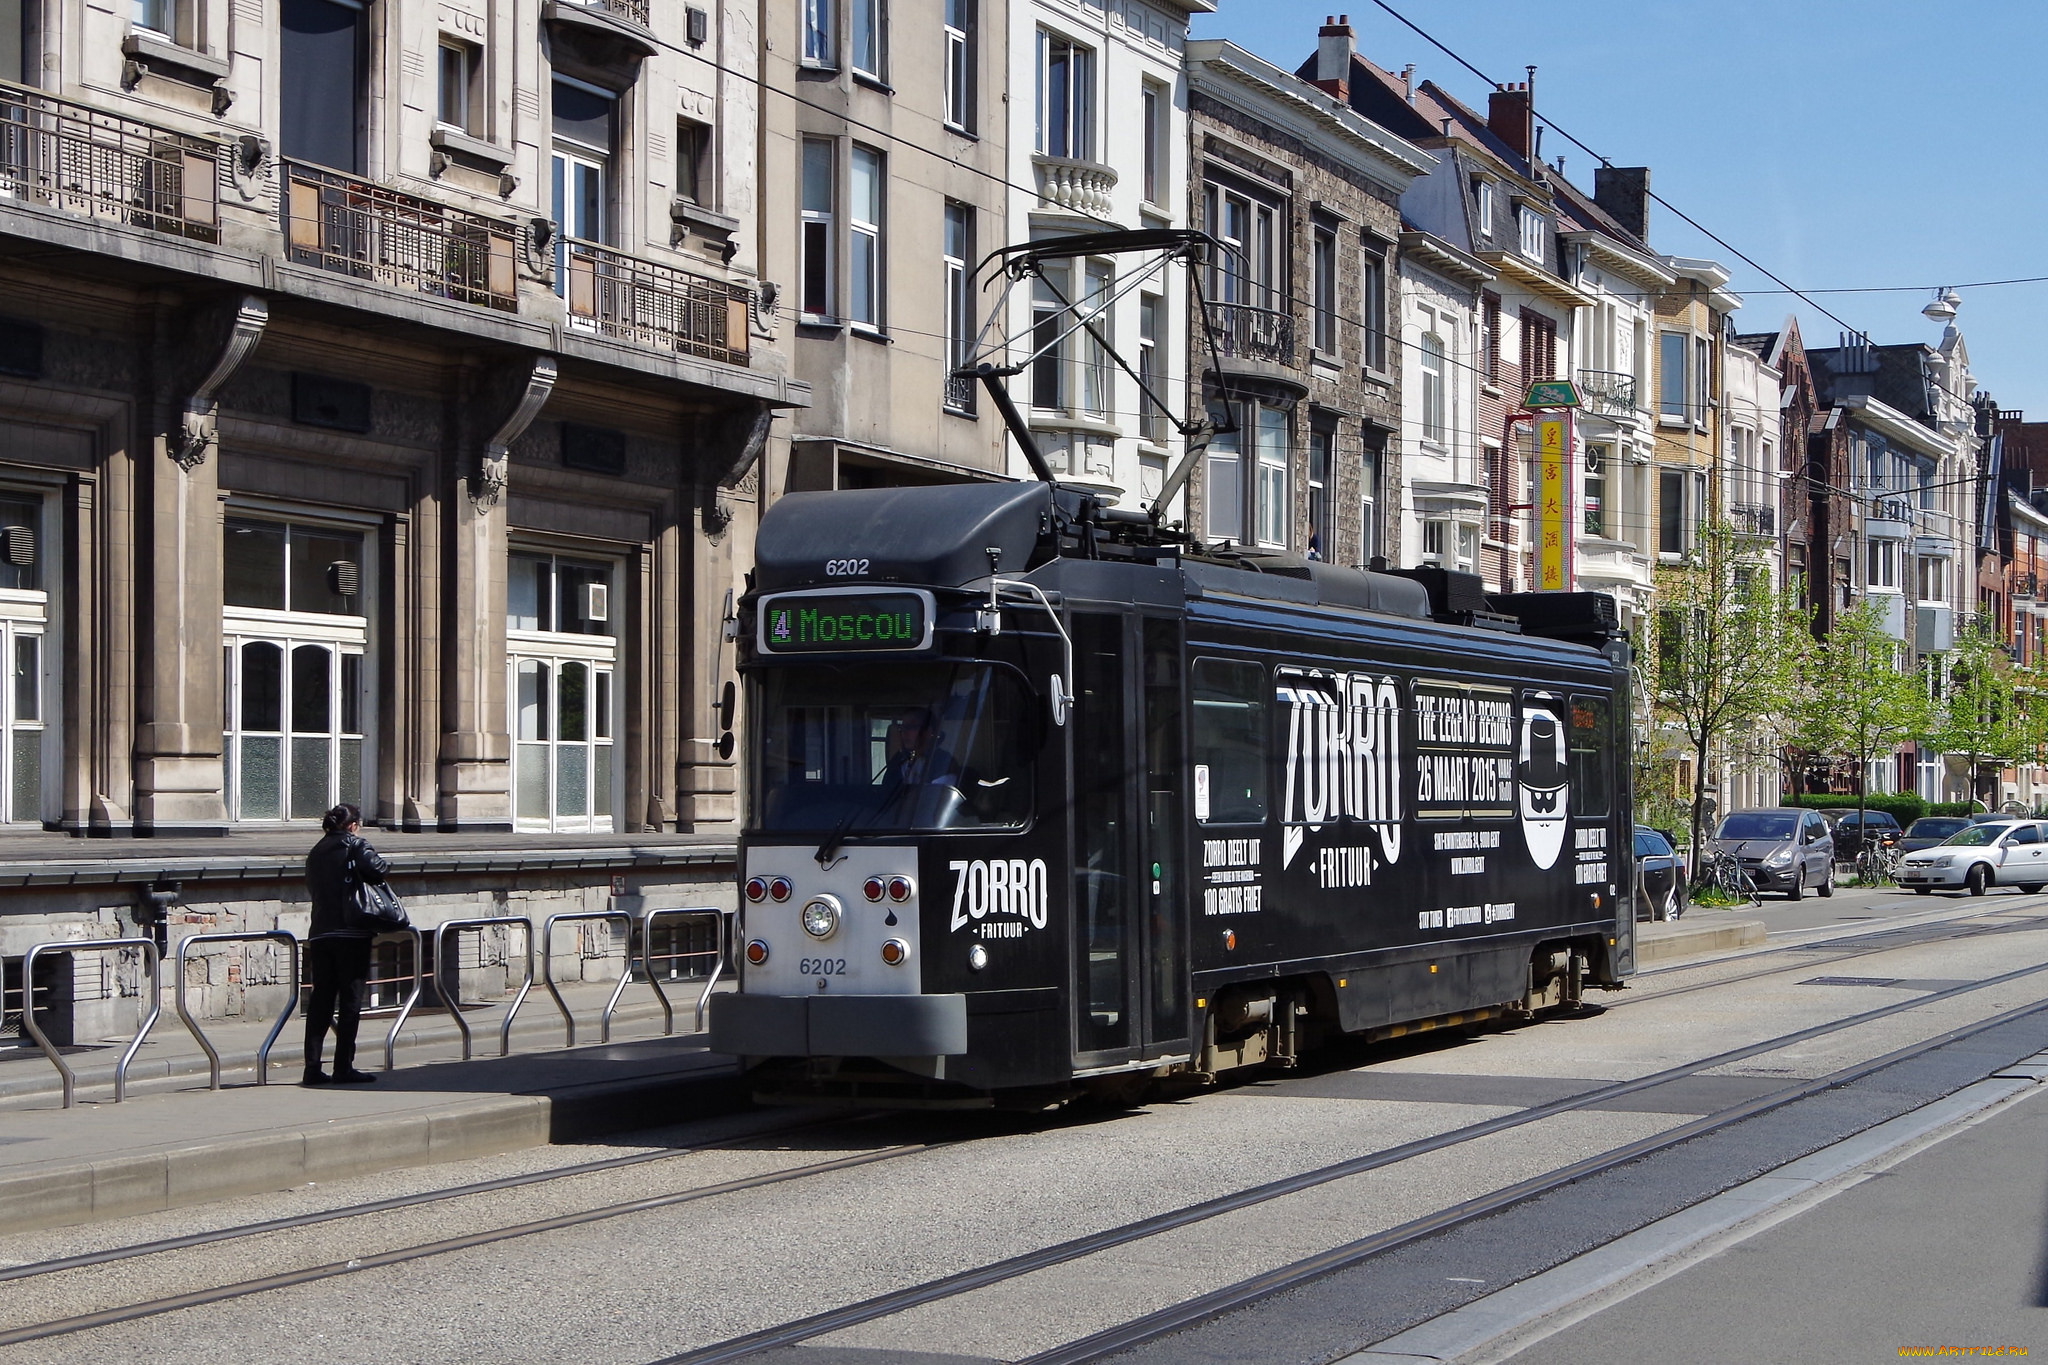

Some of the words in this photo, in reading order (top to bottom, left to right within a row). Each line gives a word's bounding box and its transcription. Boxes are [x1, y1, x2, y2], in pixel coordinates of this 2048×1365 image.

[826, 558, 870, 576] 6202
[772, 609, 791, 640] 4
[1416, 695, 1437, 741] THE
[1439, 697, 1476, 743] LEGEND
[1478, 700, 1512, 746] BEGINS
[1278, 669, 1401, 871] ZORRO
[1417, 755, 1432, 802] 26
[1434, 755, 1469, 801] MAART
[1472, 757, 1496, 802] 2015
[1203, 839, 1227, 867] ZORRO
[1227, 838, 1248, 866] DEELT
[1248, 838, 1261, 866] UIT
[1319, 846, 1371, 889] FRITUUR
[949, 858, 1049, 934] ZORRO
[1204, 888, 1218, 916] 100
[1218, 886, 1243, 915] GRATIS
[1243, 885, 1262, 913] FRIET
[980, 922, 1023, 939] FRITUUR
[799, 958, 847, 976] 6202
